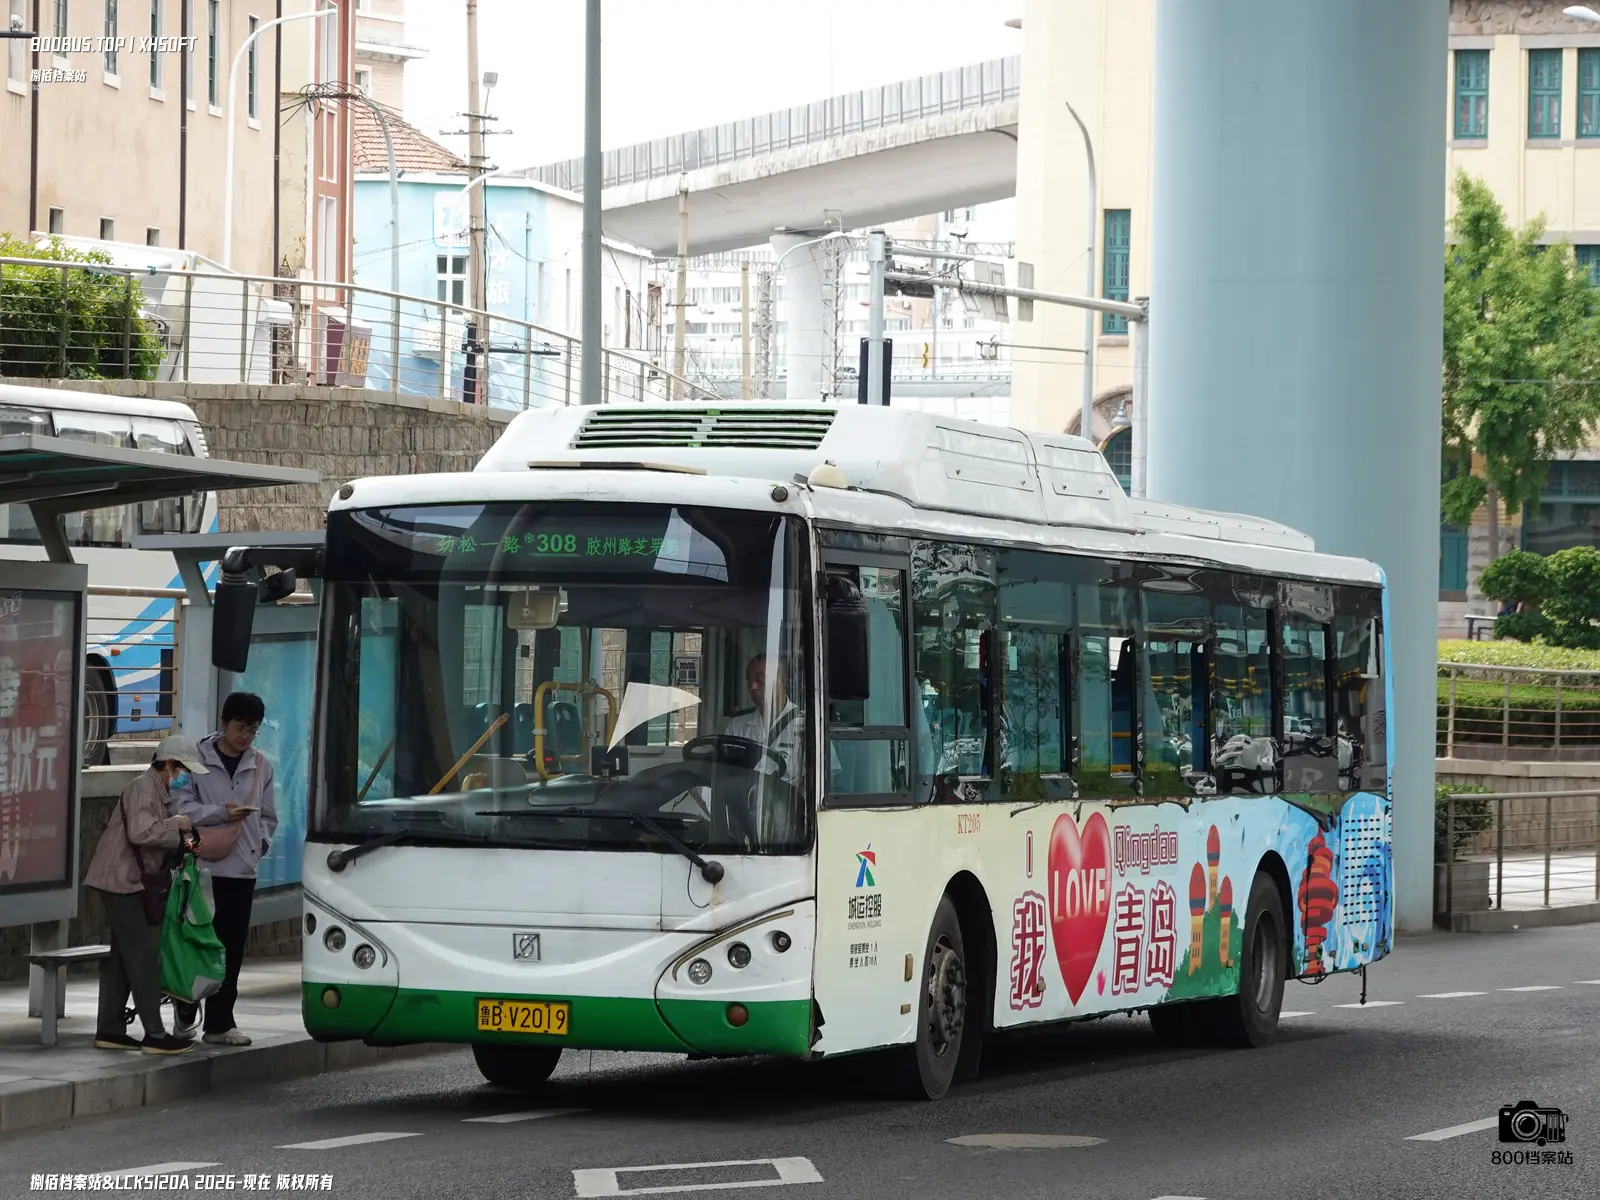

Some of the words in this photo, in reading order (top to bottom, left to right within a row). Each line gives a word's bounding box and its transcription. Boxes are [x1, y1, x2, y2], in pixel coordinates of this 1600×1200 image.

[436, 535, 522, 553] 劲松一路
[537, 534, 577, 553] 308
[1026, 830, 1034, 878] I
[1053, 868, 1106, 923] LOVE
[1114, 823, 1178, 877] Qingdao
[848, 893, 882, 919] 城运控股
[1010, 890, 1046, 1010] 我
[1111, 879, 1178, 996] 青岛
